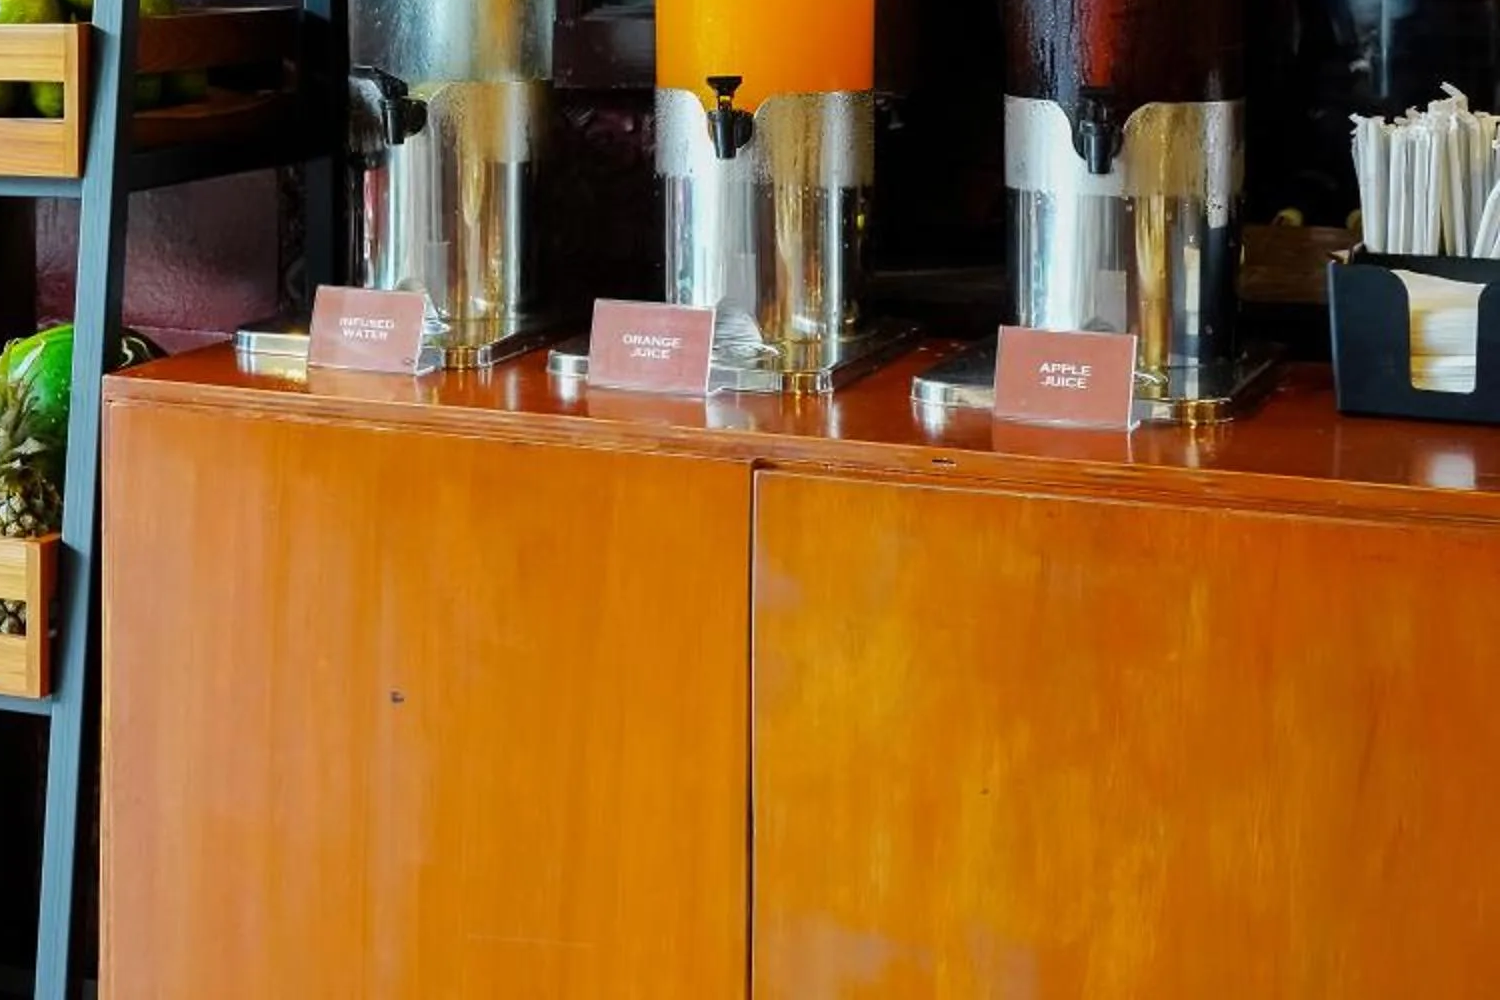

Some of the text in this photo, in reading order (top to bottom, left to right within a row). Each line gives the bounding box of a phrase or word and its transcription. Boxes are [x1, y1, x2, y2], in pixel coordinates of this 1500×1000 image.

[339, 317, 396, 330] INFUSED
[341, 328, 389, 341] WATER
[622, 334, 683, 349] ORANGE
[629, 347, 672, 360] JUICE
[1039, 362, 1093, 377] APPLE
[1040, 375, 1088, 390] JUICE
